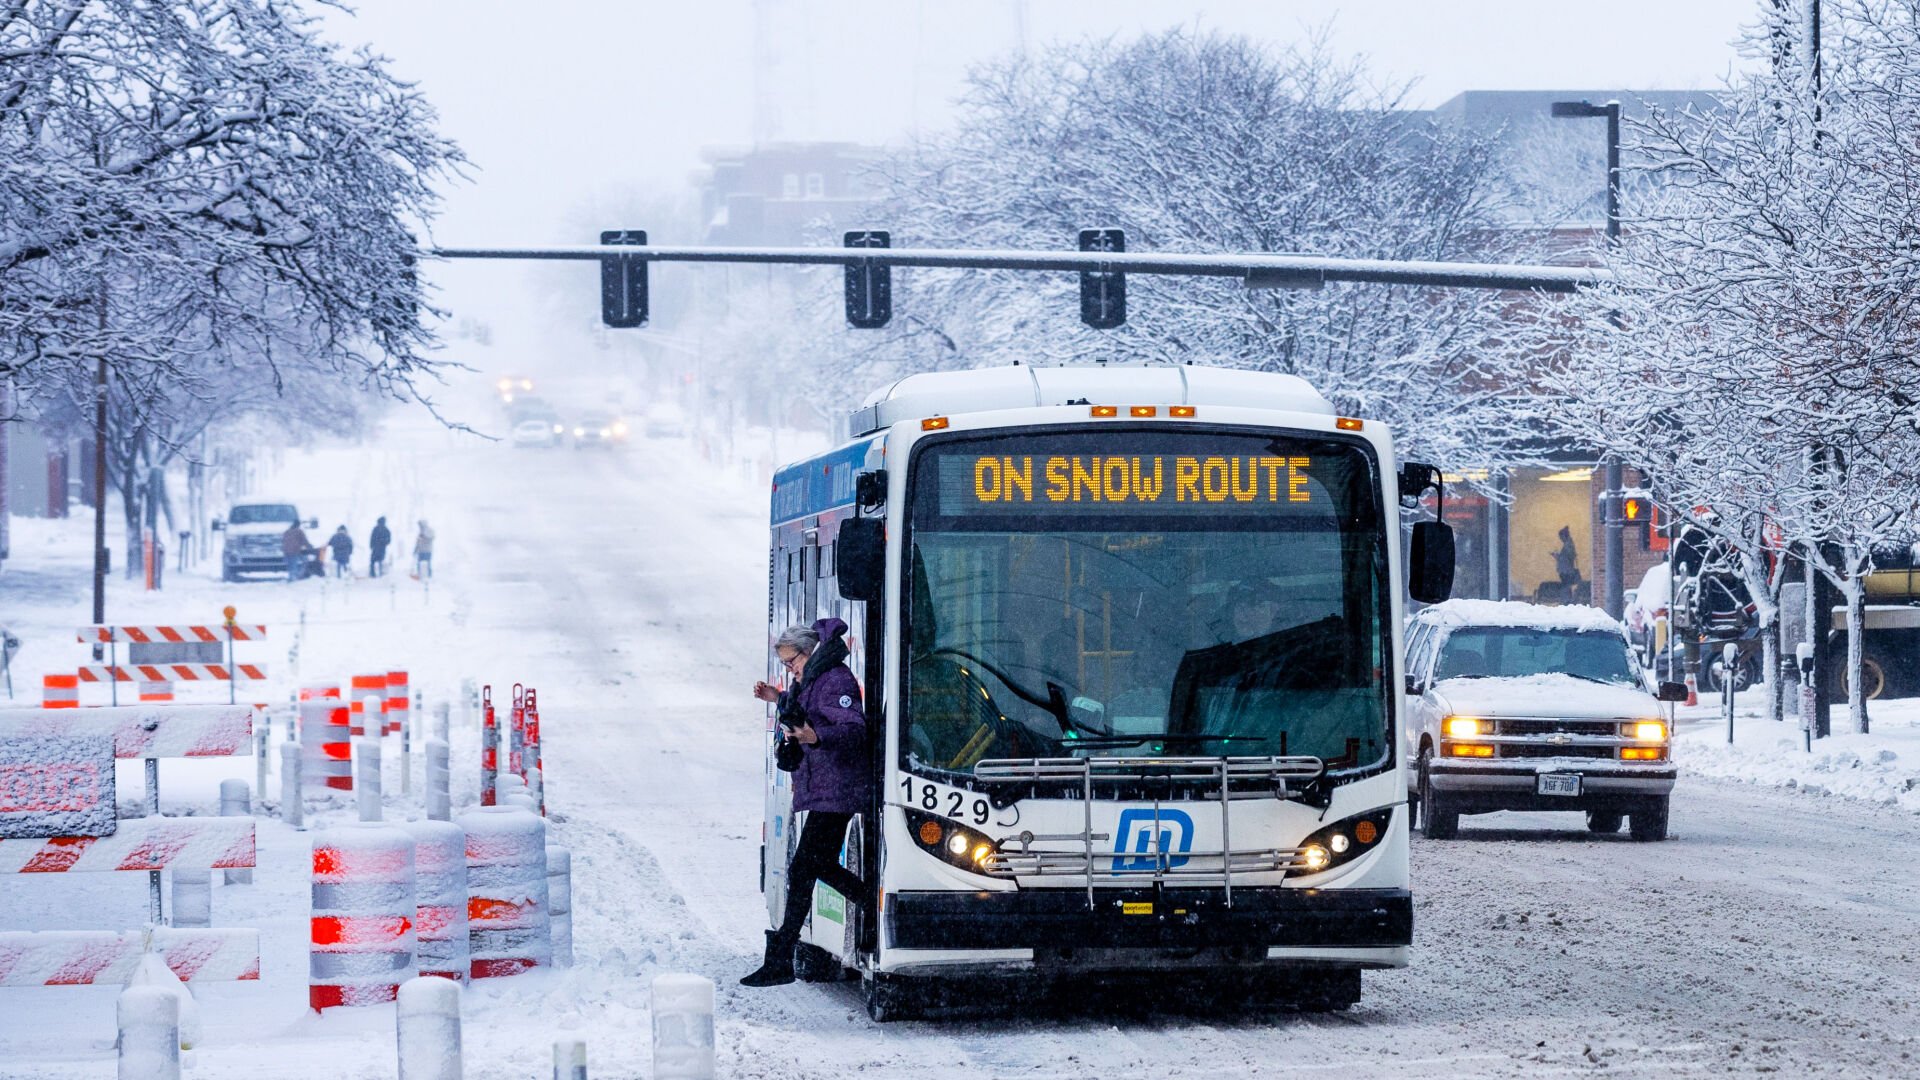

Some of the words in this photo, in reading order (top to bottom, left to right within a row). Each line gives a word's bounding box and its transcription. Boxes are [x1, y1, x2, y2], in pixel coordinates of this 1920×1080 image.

[974, 456, 1032, 501] ON
[1046, 456, 1163, 501] SNOW
[1176, 456, 1310, 501] ROUTE
[901, 776, 989, 825] 1829
